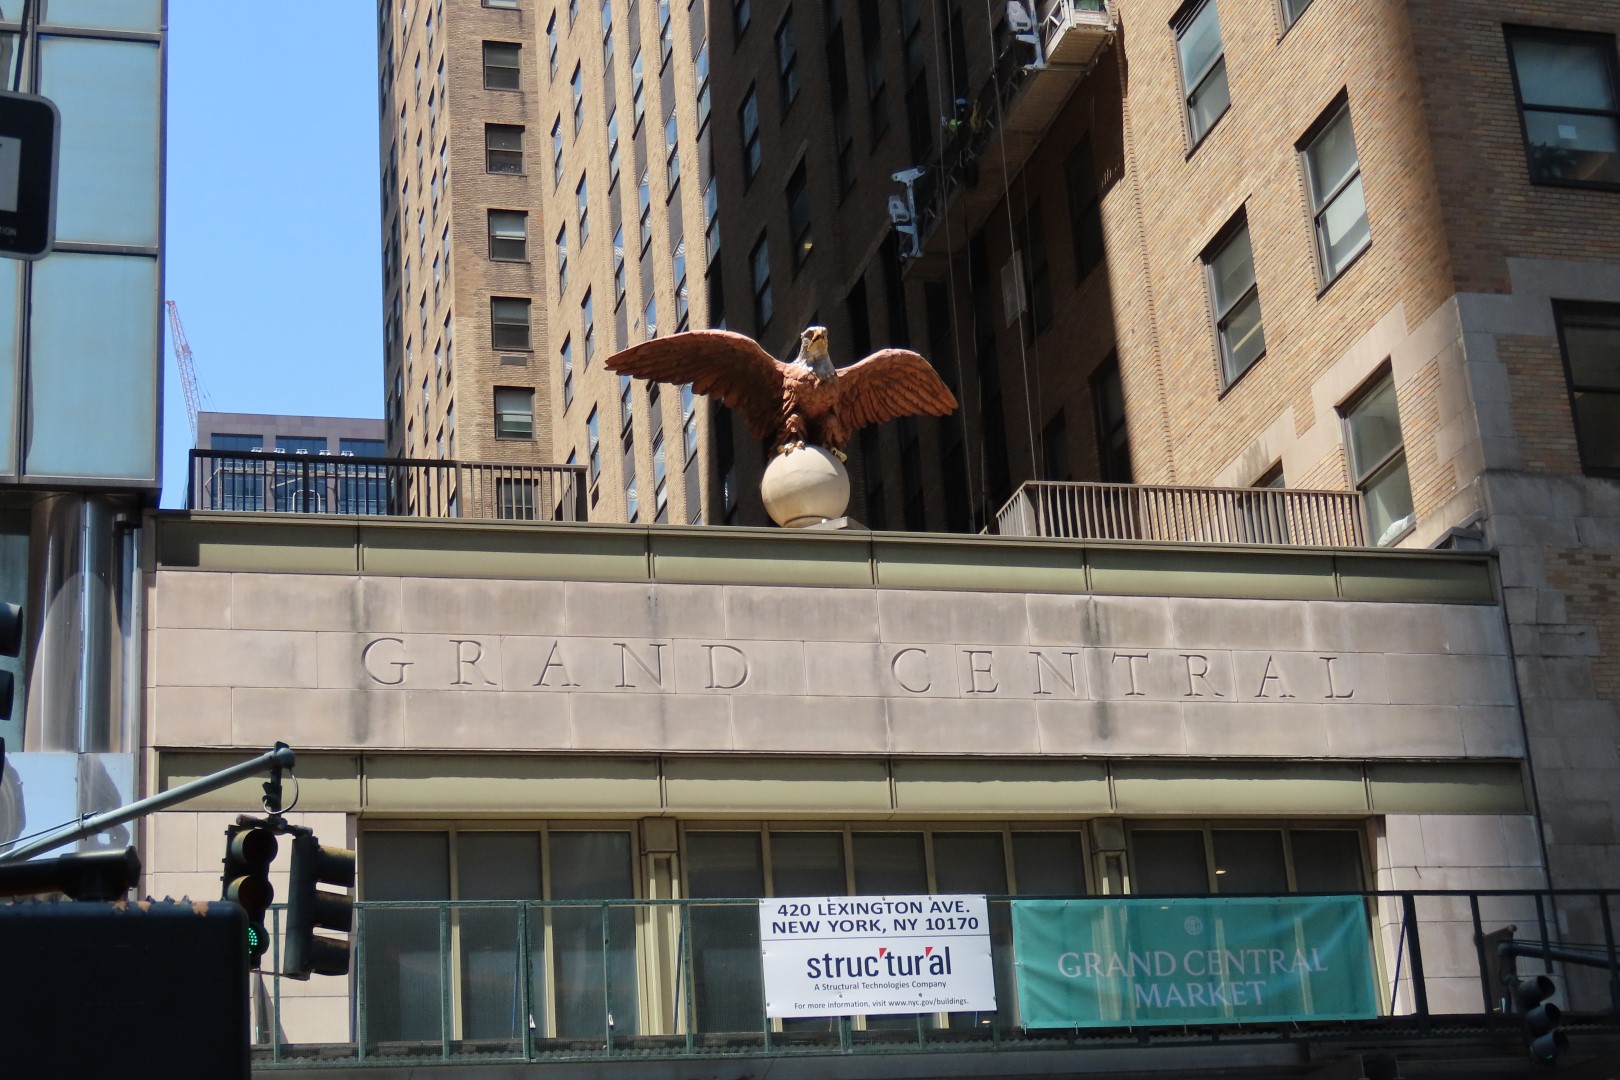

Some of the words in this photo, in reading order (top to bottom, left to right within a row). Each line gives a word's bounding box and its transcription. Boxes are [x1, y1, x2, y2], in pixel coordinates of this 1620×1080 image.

[360, 637, 752, 690] GRAND
[890, 647, 1355, 700] CENTRAL
[777, 903, 811, 917] 420
[818, 901, 923, 916] LEXINGTON
[929, 900, 970, 914] AVE.
[772, 920, 820, 935] NEW
[828, 918, 887, 935] YORK,
[893, 917, 918, 932] NY
[925, 916, 979, 931] 10170
[1057, 950, 1178, 978] GRAND
[1183, 947, 1329, 977] CENTRAL
[814, 983, 820, 991] A
[822, 981, 860, 991] Structural
[861, 980, 910, 990] Technologies
[911, 980, 947, 989] Company
[1135, 980, 1266, 1009] MARKET
[794, 1002, 805, 1010] For
[827, 1000, 871, 1009] information,
[872, 999, 887, 1007] visit
